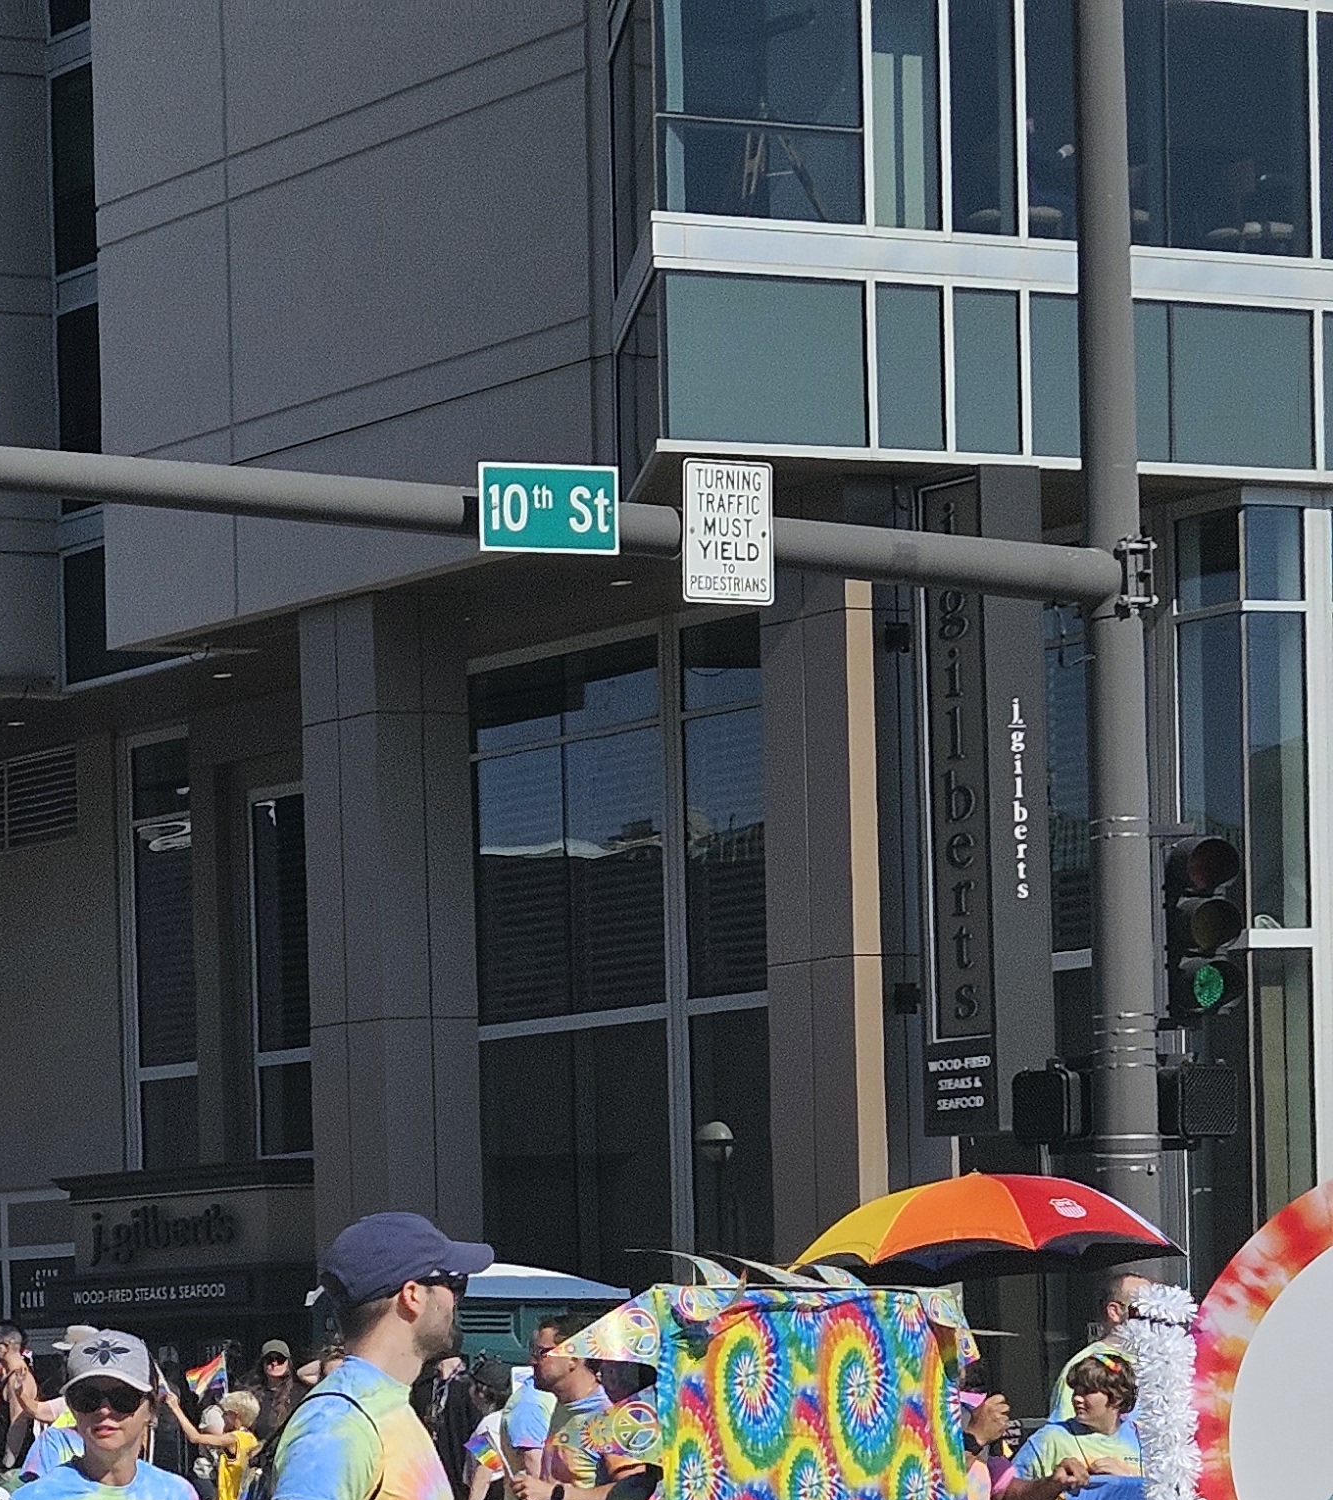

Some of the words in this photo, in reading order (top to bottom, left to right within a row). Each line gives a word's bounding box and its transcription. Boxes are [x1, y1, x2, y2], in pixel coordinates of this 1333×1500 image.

[695, 468, 762, 491] TURNING
[488, 483, 553, 532] 10th
[569, 486, 611, 533] St
[697, 492, 761, 515] TRAFFIC
[703, 518, 752, 538] MUST
[698, 539, 760, 562] YIELD
[722, 563, 736, 574] TO
[689, 574, 767, 594] PEDESTRIANS
[937, 1096, 984, 1110] SEAFOOD
[73, 1288, 133, 1305] WOOD-FIRED
[134, 1286, 168, 1301] STEAKS
[169, 1286, 177, 1299] &
[179, 1283, 225, 1299] SEAFOOD
